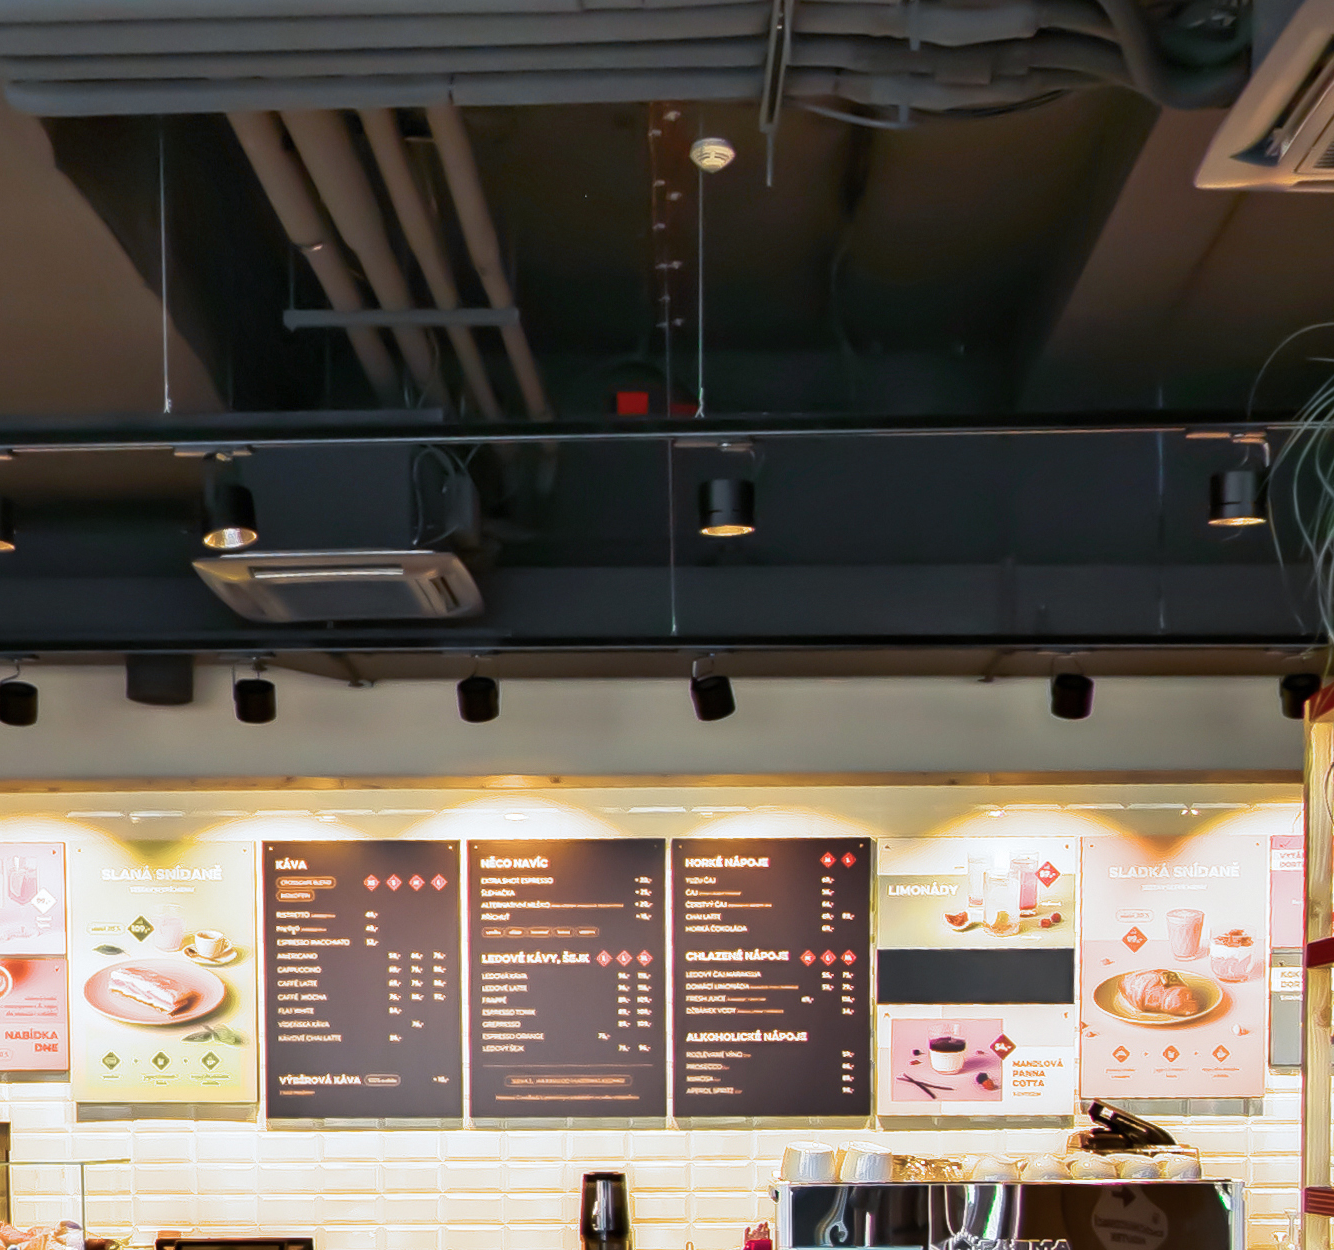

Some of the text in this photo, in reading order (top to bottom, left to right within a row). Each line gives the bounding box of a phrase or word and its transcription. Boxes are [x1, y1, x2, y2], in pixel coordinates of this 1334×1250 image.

[275, 857, 308, 871] KÁVA
[480, 856, 549, 869] NĚCO NAVÍC
[685, 855, 770, 868] HORKÉ NÁPOJE
[101, 865, 222, 881] SLANÁ SNÍDANĚ
[1109, 862, 1240, 878] SLADKÁ SNÍDANĚ
[685, 889, 698, 897] ČAJ
[888, 882, 959, 896] LIMONÁDY
[131, 924, 150, 934] 109,-
[481, 951, 590, 965] LEDOVÉ KÁVY, ŠEJK
[685, 949, 790, 962] CHLAZENÉ NÁPOJE
[277, 966, 322, 974] CAPPUCCINO
[4, 1028, 58, 1040] NABÍDKA
[685, 1029, 808, 1042] ALKOHOLICKÉ NÁPOJE
[34, 1043, 58, 1052] DNE
[1012, 1058, 1064, 1067] MANDLOVÁ
[279, 1073, 362, 1085] VÝBĚROVÁ KÁVA
[1013, 1079, 1045, 1087] COTTA
